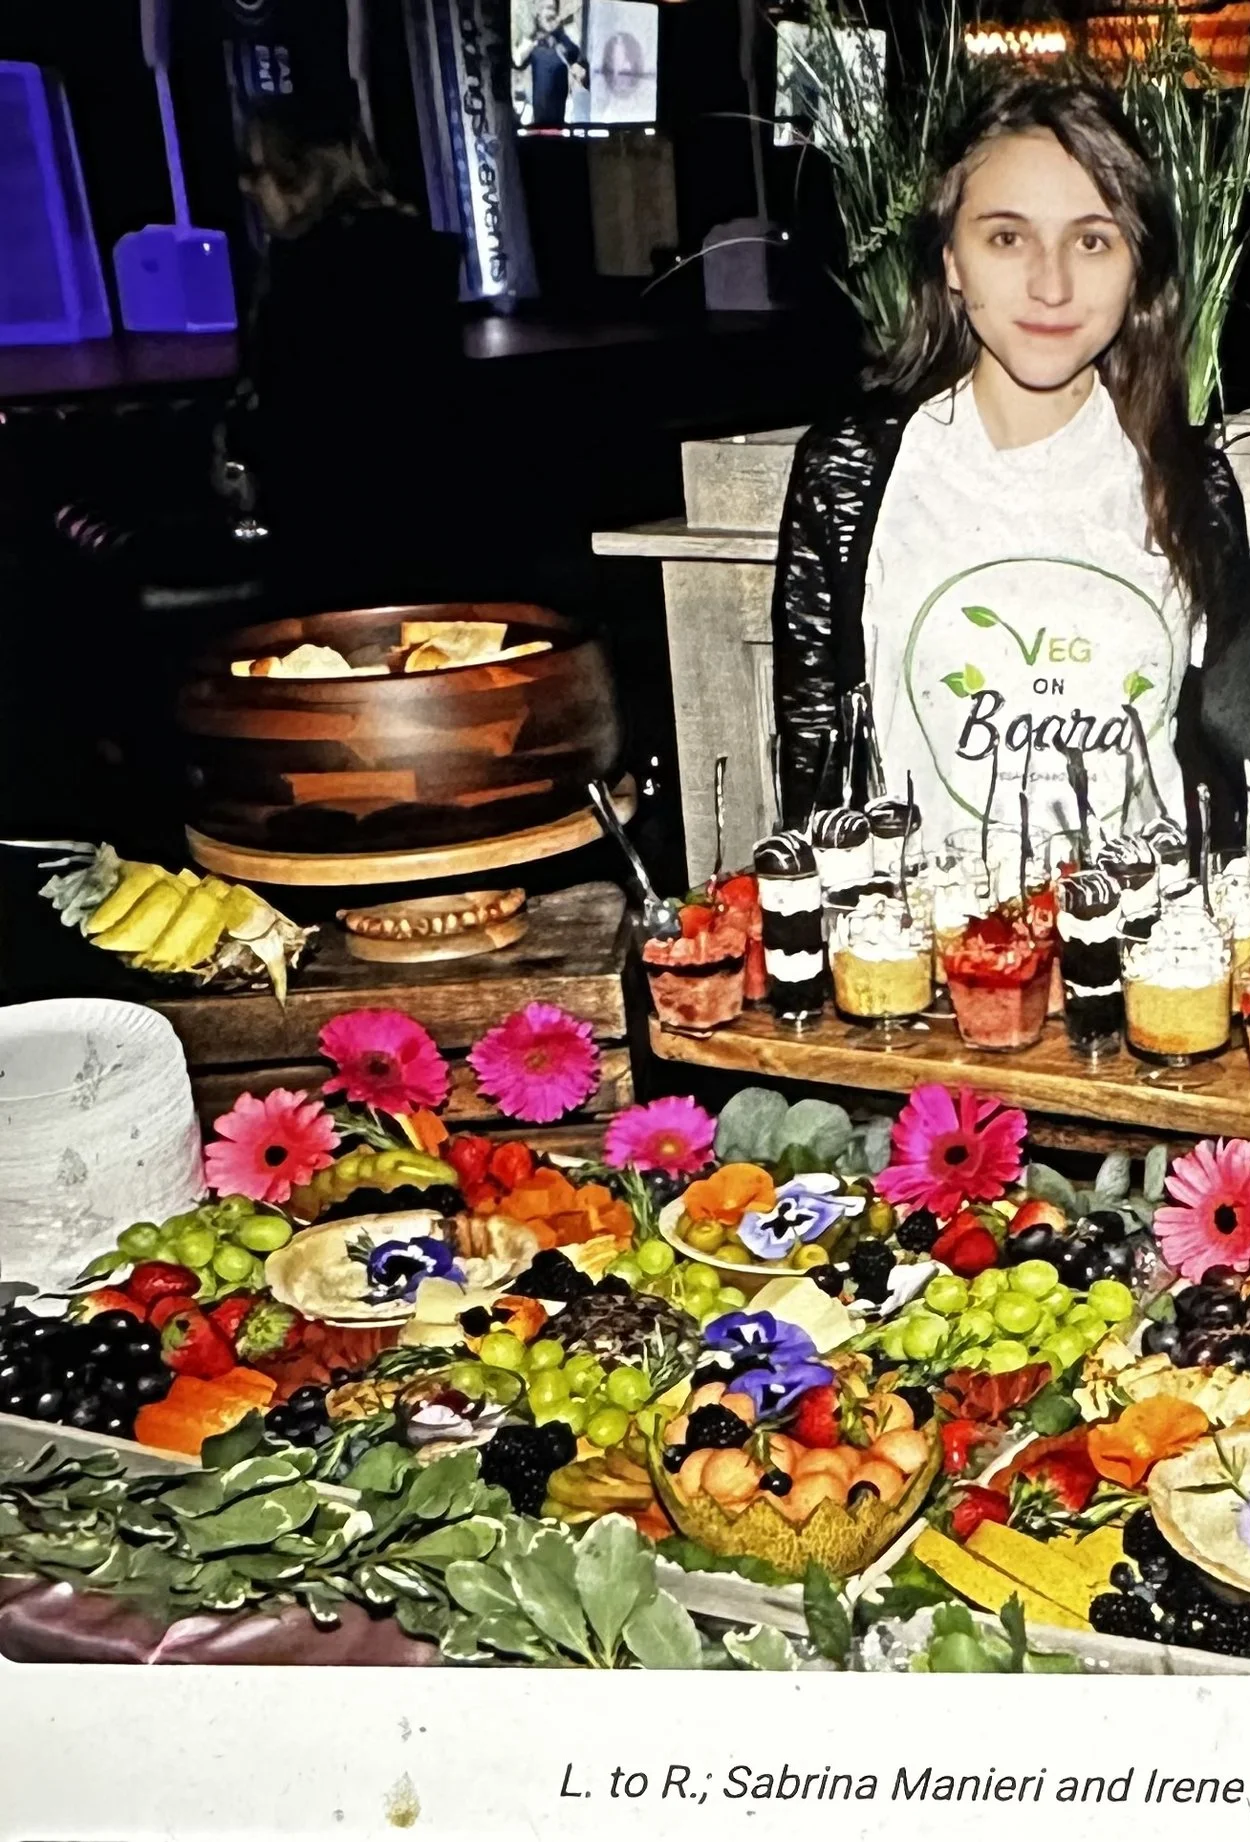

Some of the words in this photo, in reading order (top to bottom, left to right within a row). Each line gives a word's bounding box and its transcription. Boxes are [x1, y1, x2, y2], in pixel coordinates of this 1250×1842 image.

[990, 614, 1093, 667] VEG
[1032, 677, 1065, 696] ON
[955, 688, 1136, 761] Board
